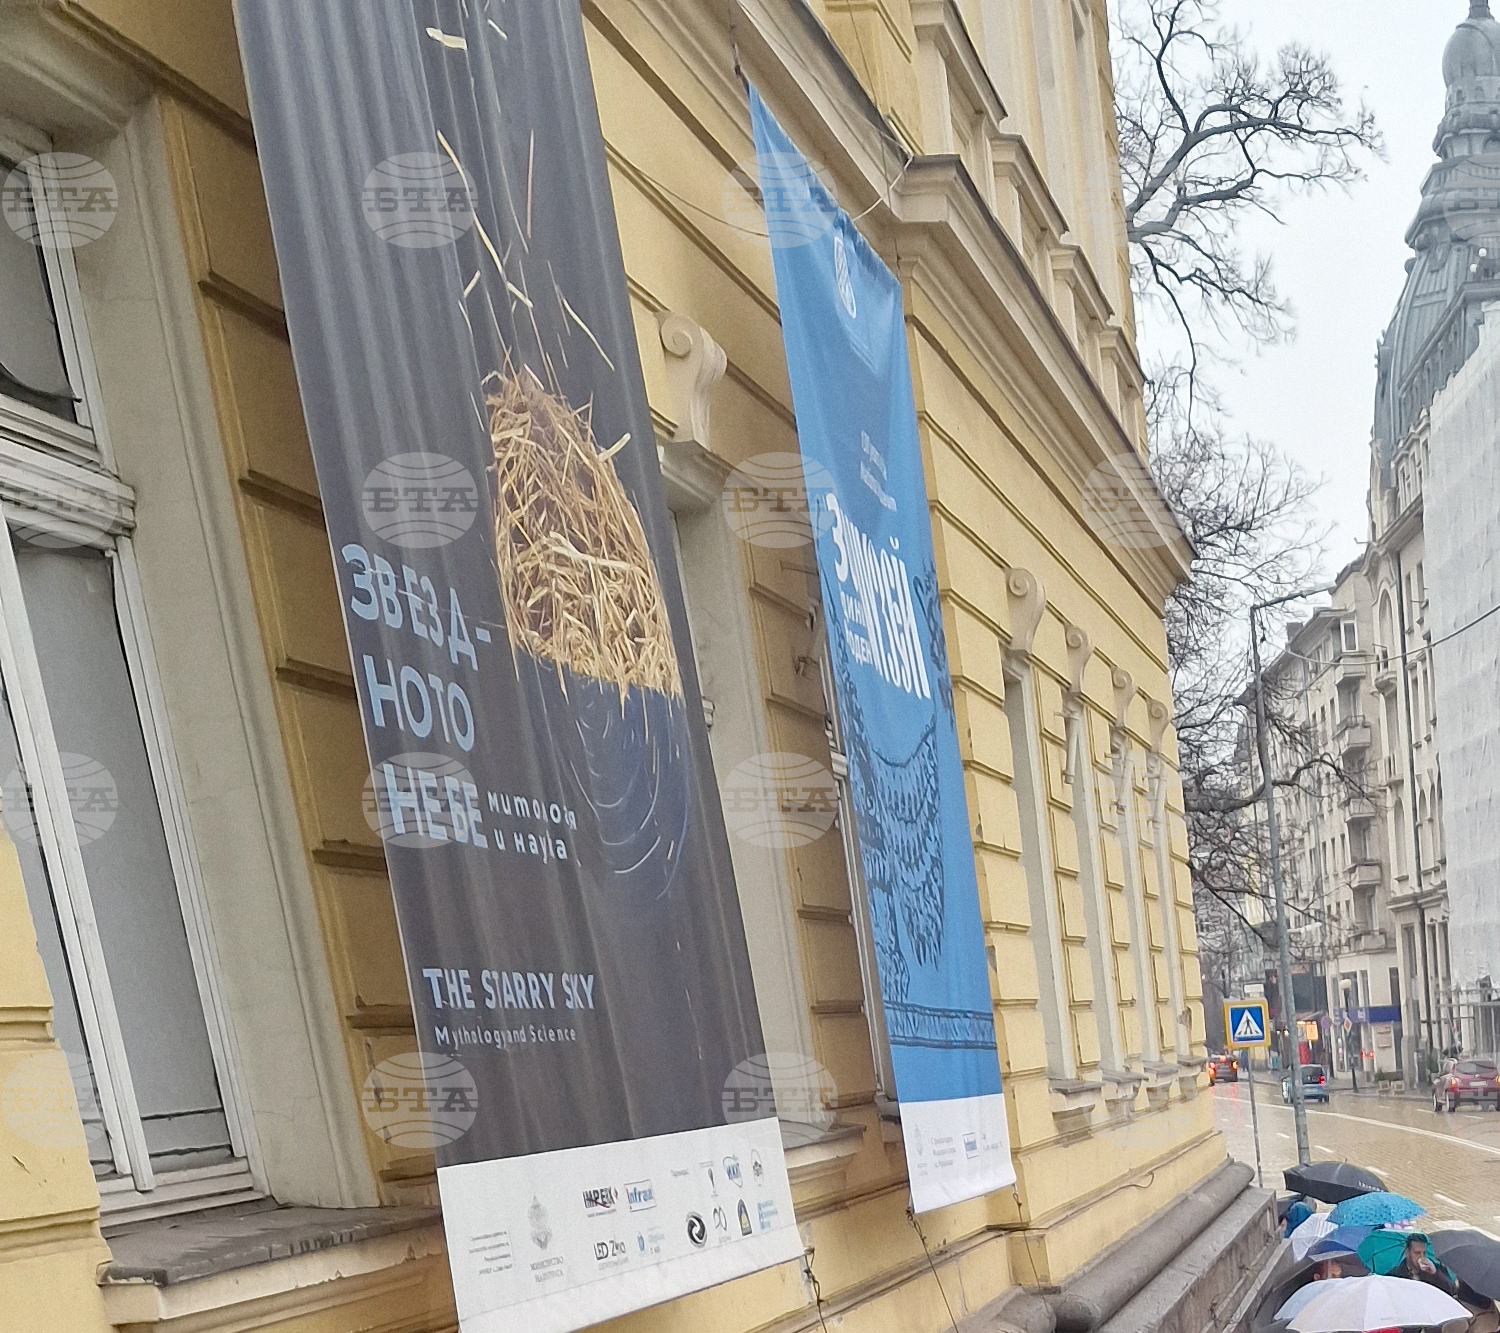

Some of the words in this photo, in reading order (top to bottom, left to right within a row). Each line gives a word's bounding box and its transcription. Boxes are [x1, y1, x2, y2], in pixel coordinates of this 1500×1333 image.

[342, 544, 491, 671] ЗВЕЗД-
[363, 655, 475, 751] НОТО
[383, 764, 488, 849] НЕБЕ
[494, 828, 506, 851] и
[422, 968, 476, 1009] THE
[481, 969, 555, 1010] STARRY
[561, 972, 594, 1010] SKY
[530, 1023, 576, 1043] Science
